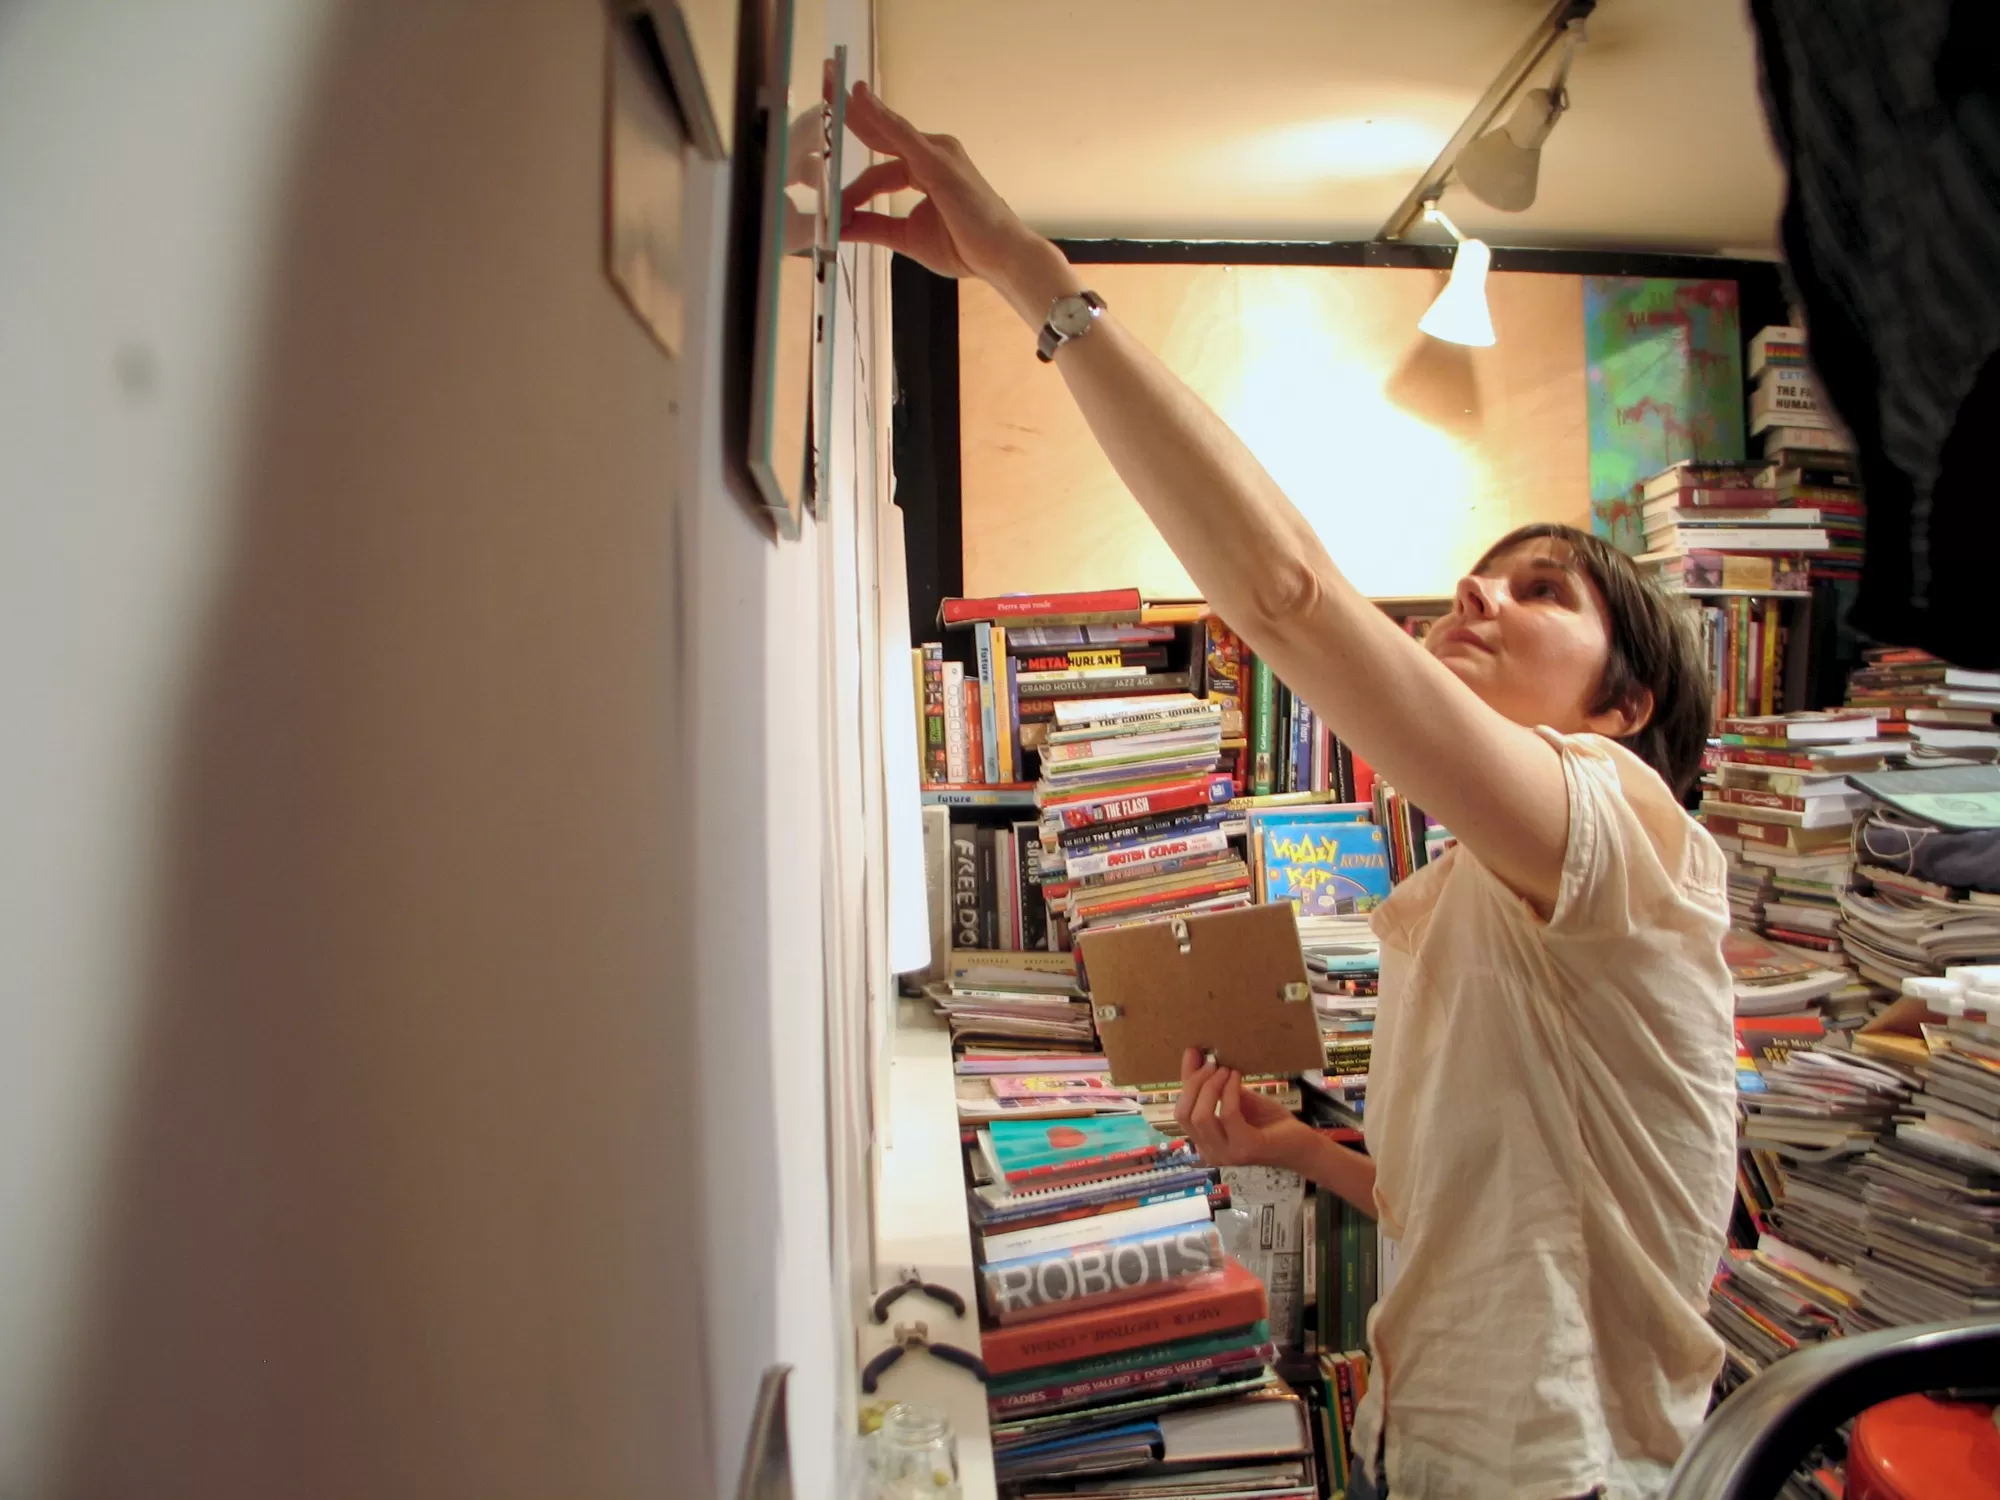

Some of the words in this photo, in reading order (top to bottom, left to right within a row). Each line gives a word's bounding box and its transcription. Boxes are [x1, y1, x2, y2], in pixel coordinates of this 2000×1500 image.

[1776, 385, 1796, 397] THE
[997, 603, 1018, 611] Pierre
[1019, 602, 1032, 612] qui
[980, 647, 990, 681] future
[1028, 656, 1069, 671] METAL
[1068, 654, 1121, 668] HURLANT
[1021, 683, 1051, 693] GRAND
[1053, 681, 1087, 690] HOTELS
[1114, 678, 1135, 688] JAZZ
[1137, 677, 1154, 686] AGE
[1099, 718, 1117, 728] THE
[1122, 711, 1163, 725] COMICS
[1166, 705, 1213, 719] JOURNAL
[948, 684, 963, 778] EURODECO
[1300, 722, 1310, 743] Years
[938, 795, 972, 803] future
[1104, 802, 1122, 819] THE
[1123, 797, 1150, 815] FLASH
[1092, 829, 1110, 841] THE
[1111, 826, 1140, 839] SPIRIT
[1107, 849, 1146, 867] BRITISH
[1148, 841, 1189, 859] COMICS
[1771, 1037, 1788, 1047] Joe
[993, 1232, 1211, 1313] ROBOTS
[1062, 1381, 1091, 1397] BORIS
[1144, 1366, 1173, 1380] DORIS
